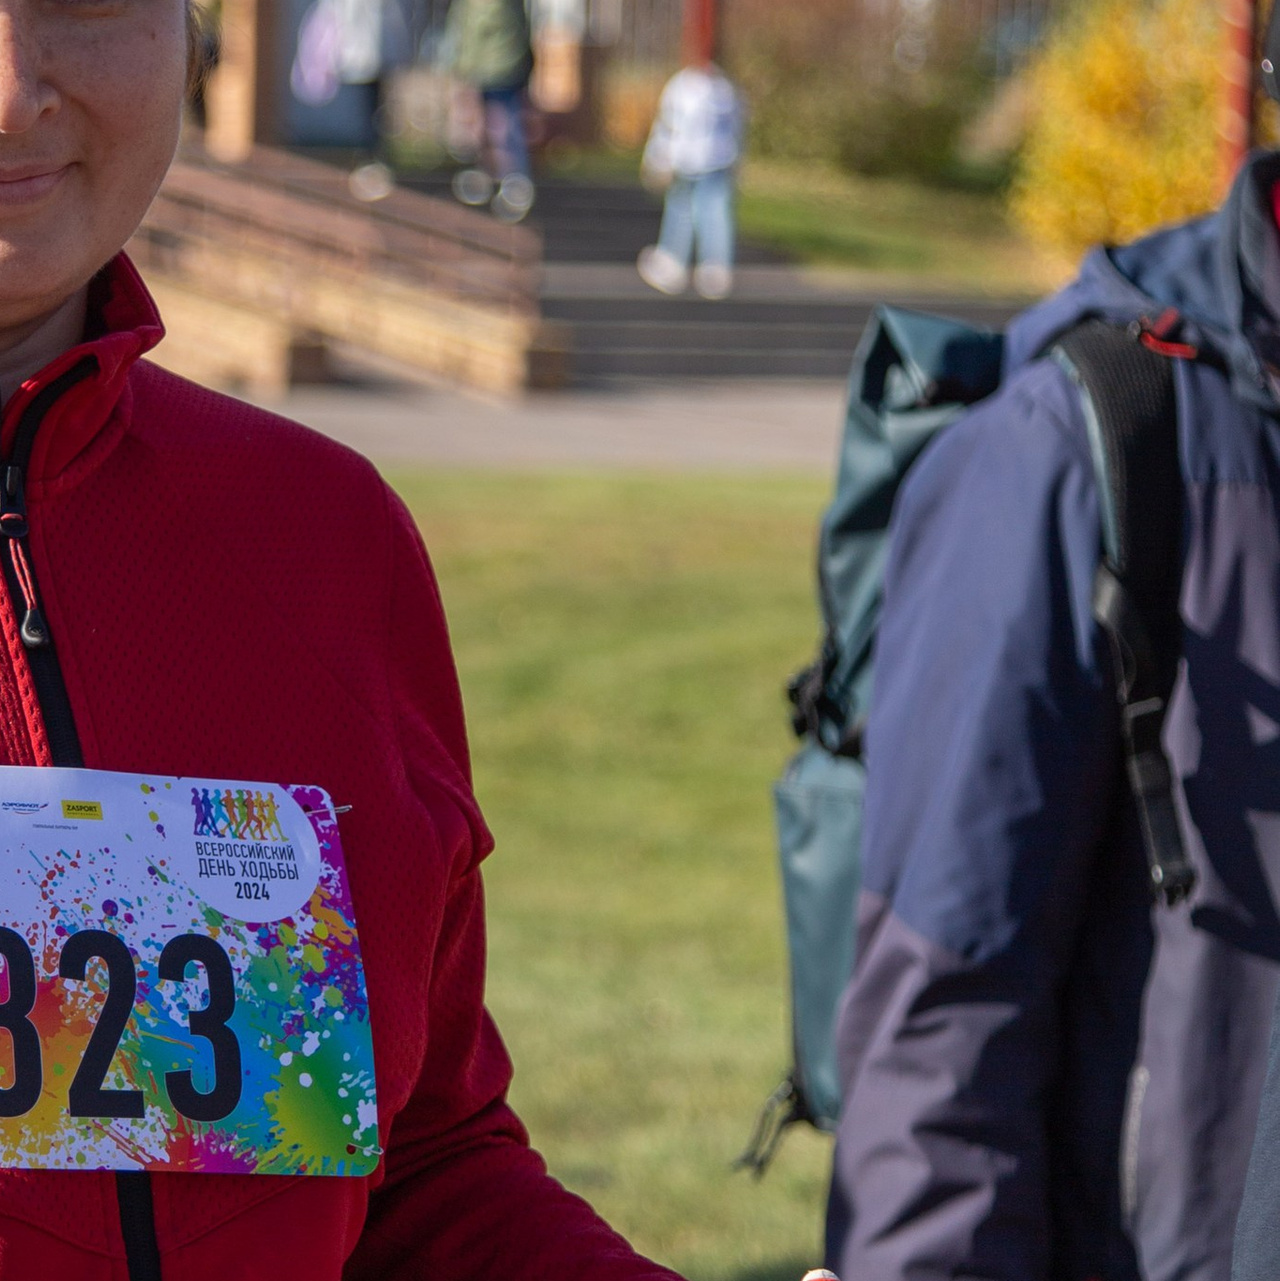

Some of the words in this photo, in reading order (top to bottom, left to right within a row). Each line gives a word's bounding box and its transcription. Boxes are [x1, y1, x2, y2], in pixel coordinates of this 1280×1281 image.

[66, 804, 97, 812] ZASPORT
[195, 841, 296, 861] ВСЕРОССИЙСКИЙ
[198, 858, 236, 878] ДЕНЬ
[239, 860, 299, 881] ХОДЬБЫ
[234, 881, 270, 900] 2024
